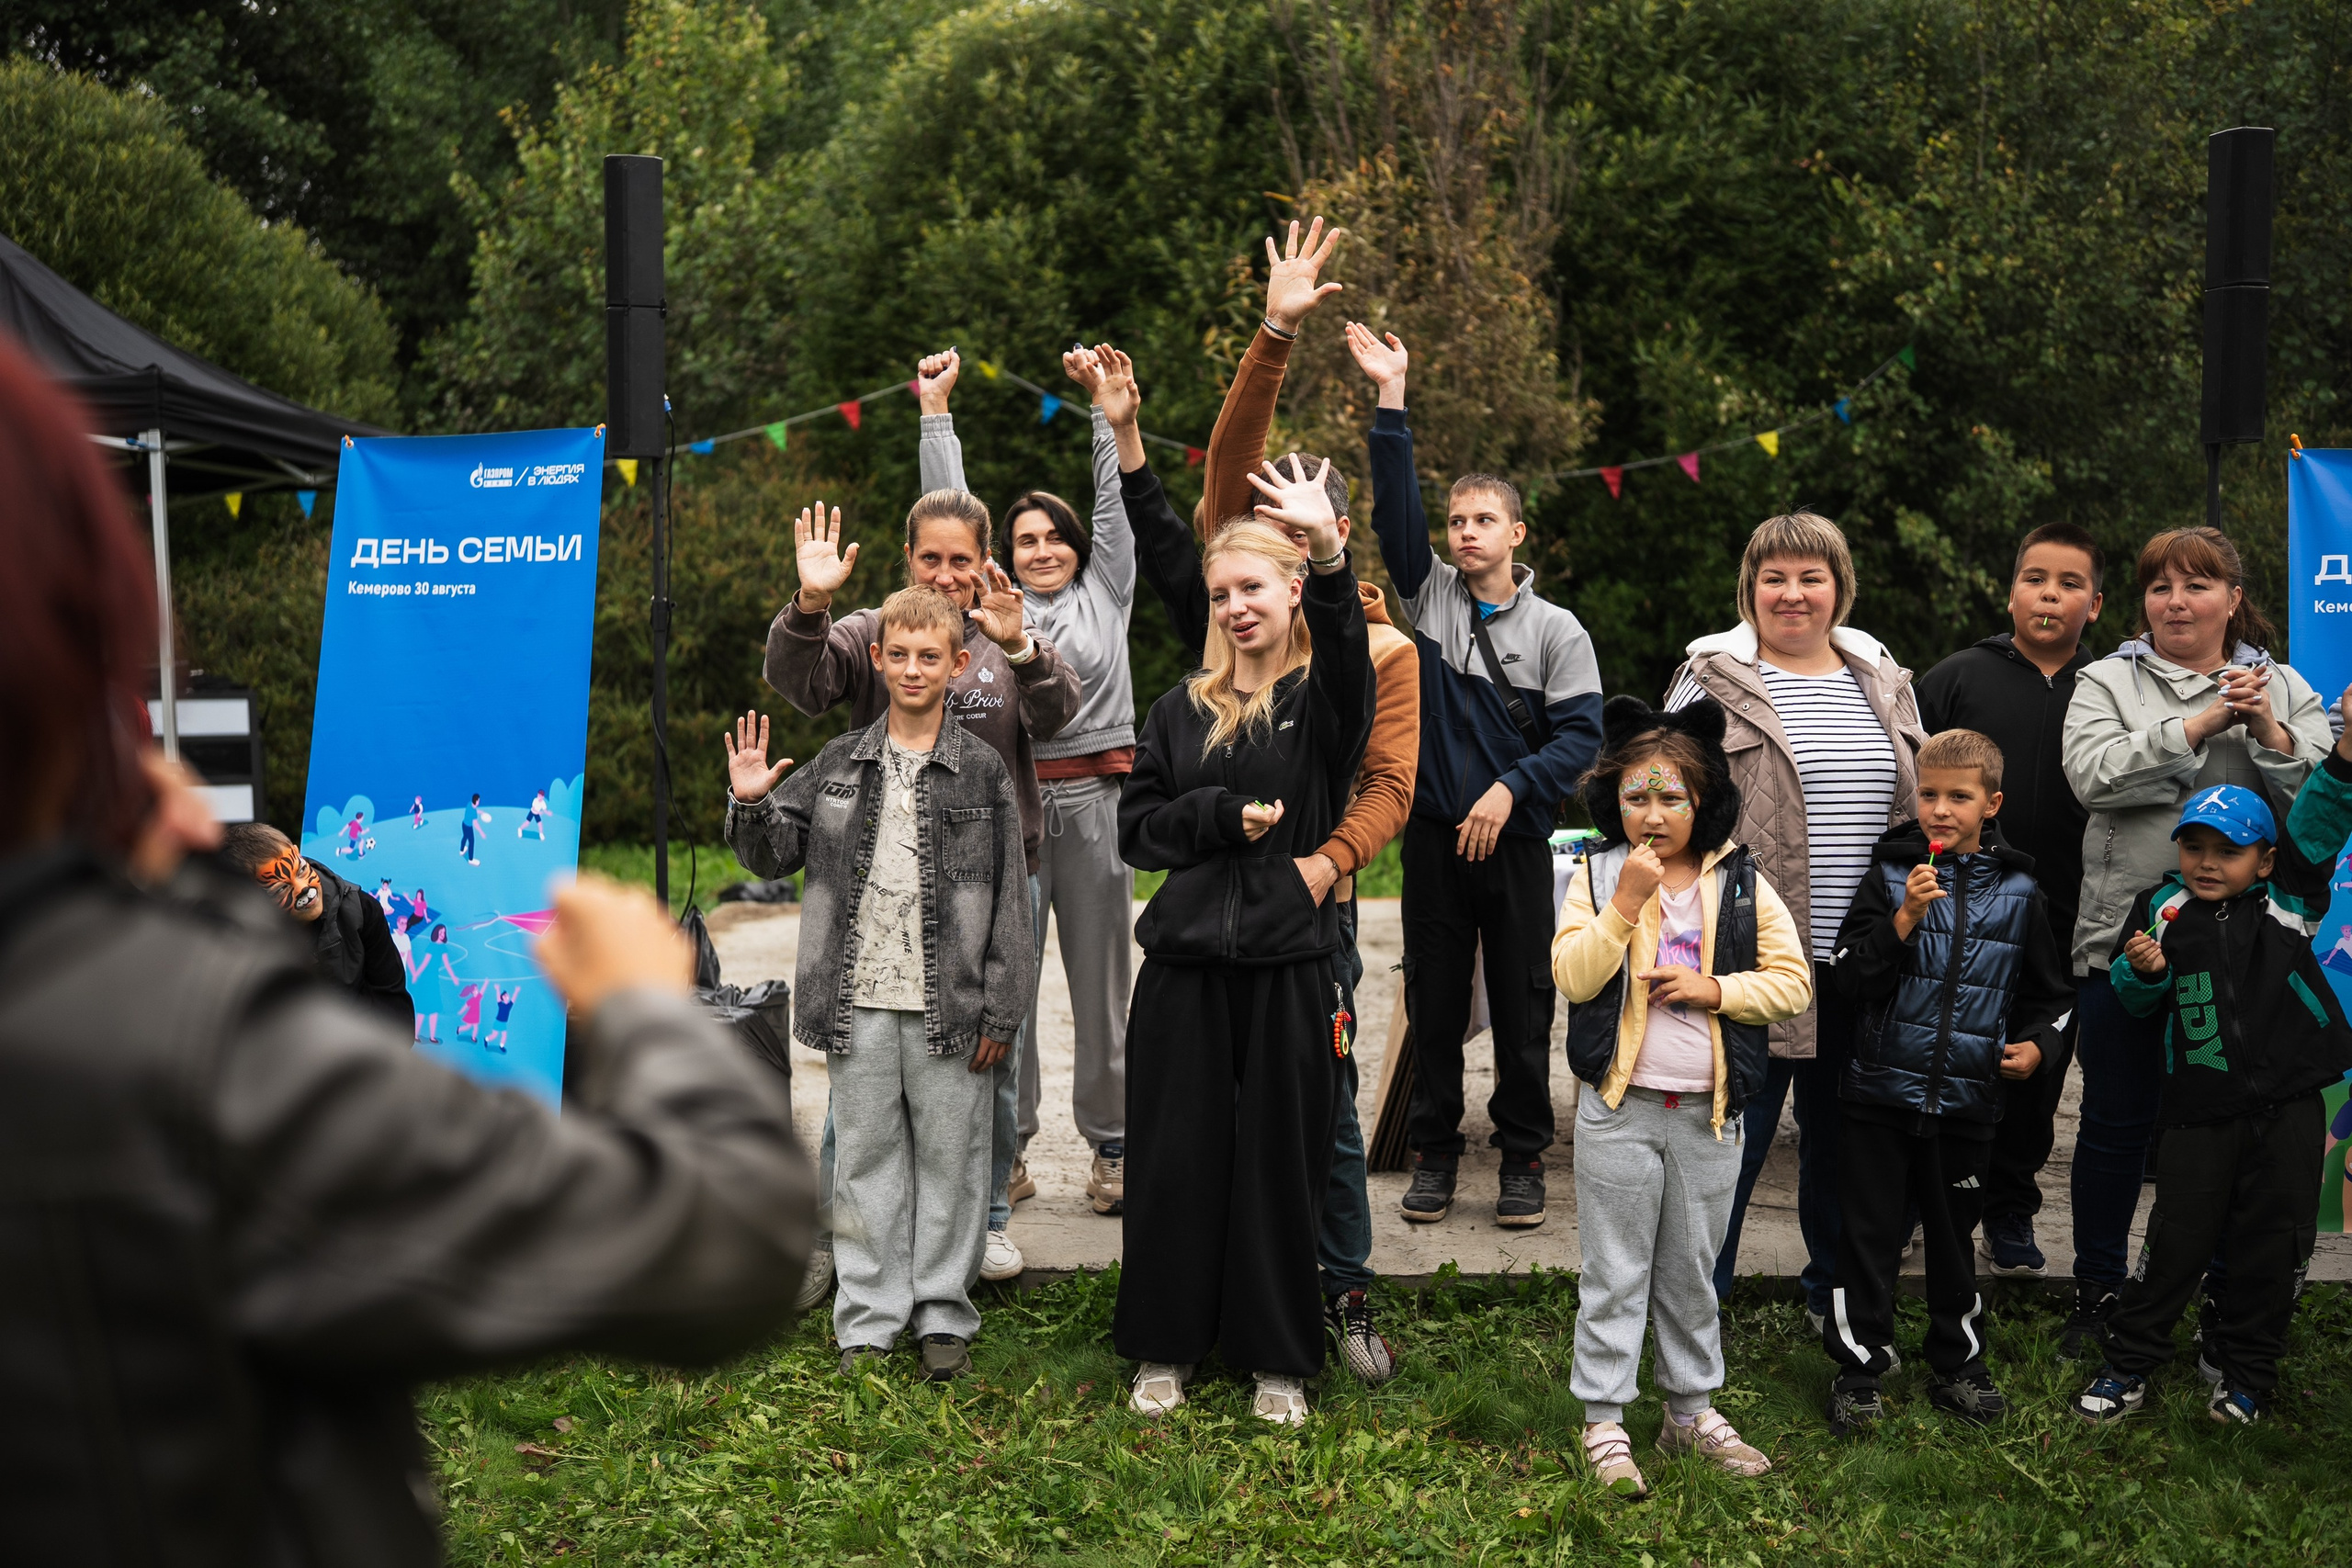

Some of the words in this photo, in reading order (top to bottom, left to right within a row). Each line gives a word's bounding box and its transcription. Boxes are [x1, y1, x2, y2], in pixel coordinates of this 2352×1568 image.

[483, 467, 514, 479] ГАЗПРОМ
[533, 463, 585, 476] ЭНЕРГИЯ
[527, 476, 537, 486] В
[537, 474, 580, 486] ЛЮДЯХ
[350, 537, 450, 569] ДЕНЬ
[458, 534, 582, 564] СЕМЬИ
[347, 580, 412, 598] Кемерово
[413, 581, 430, 595] 30
[432, 582, 477, 598] августа
[2314, 600, 2352, 614] Кем
[868, 881, 888, 896] NIKE
[900, 930, 913, 954] NIKE
[2178, 971, 2229, 1072] RDY
